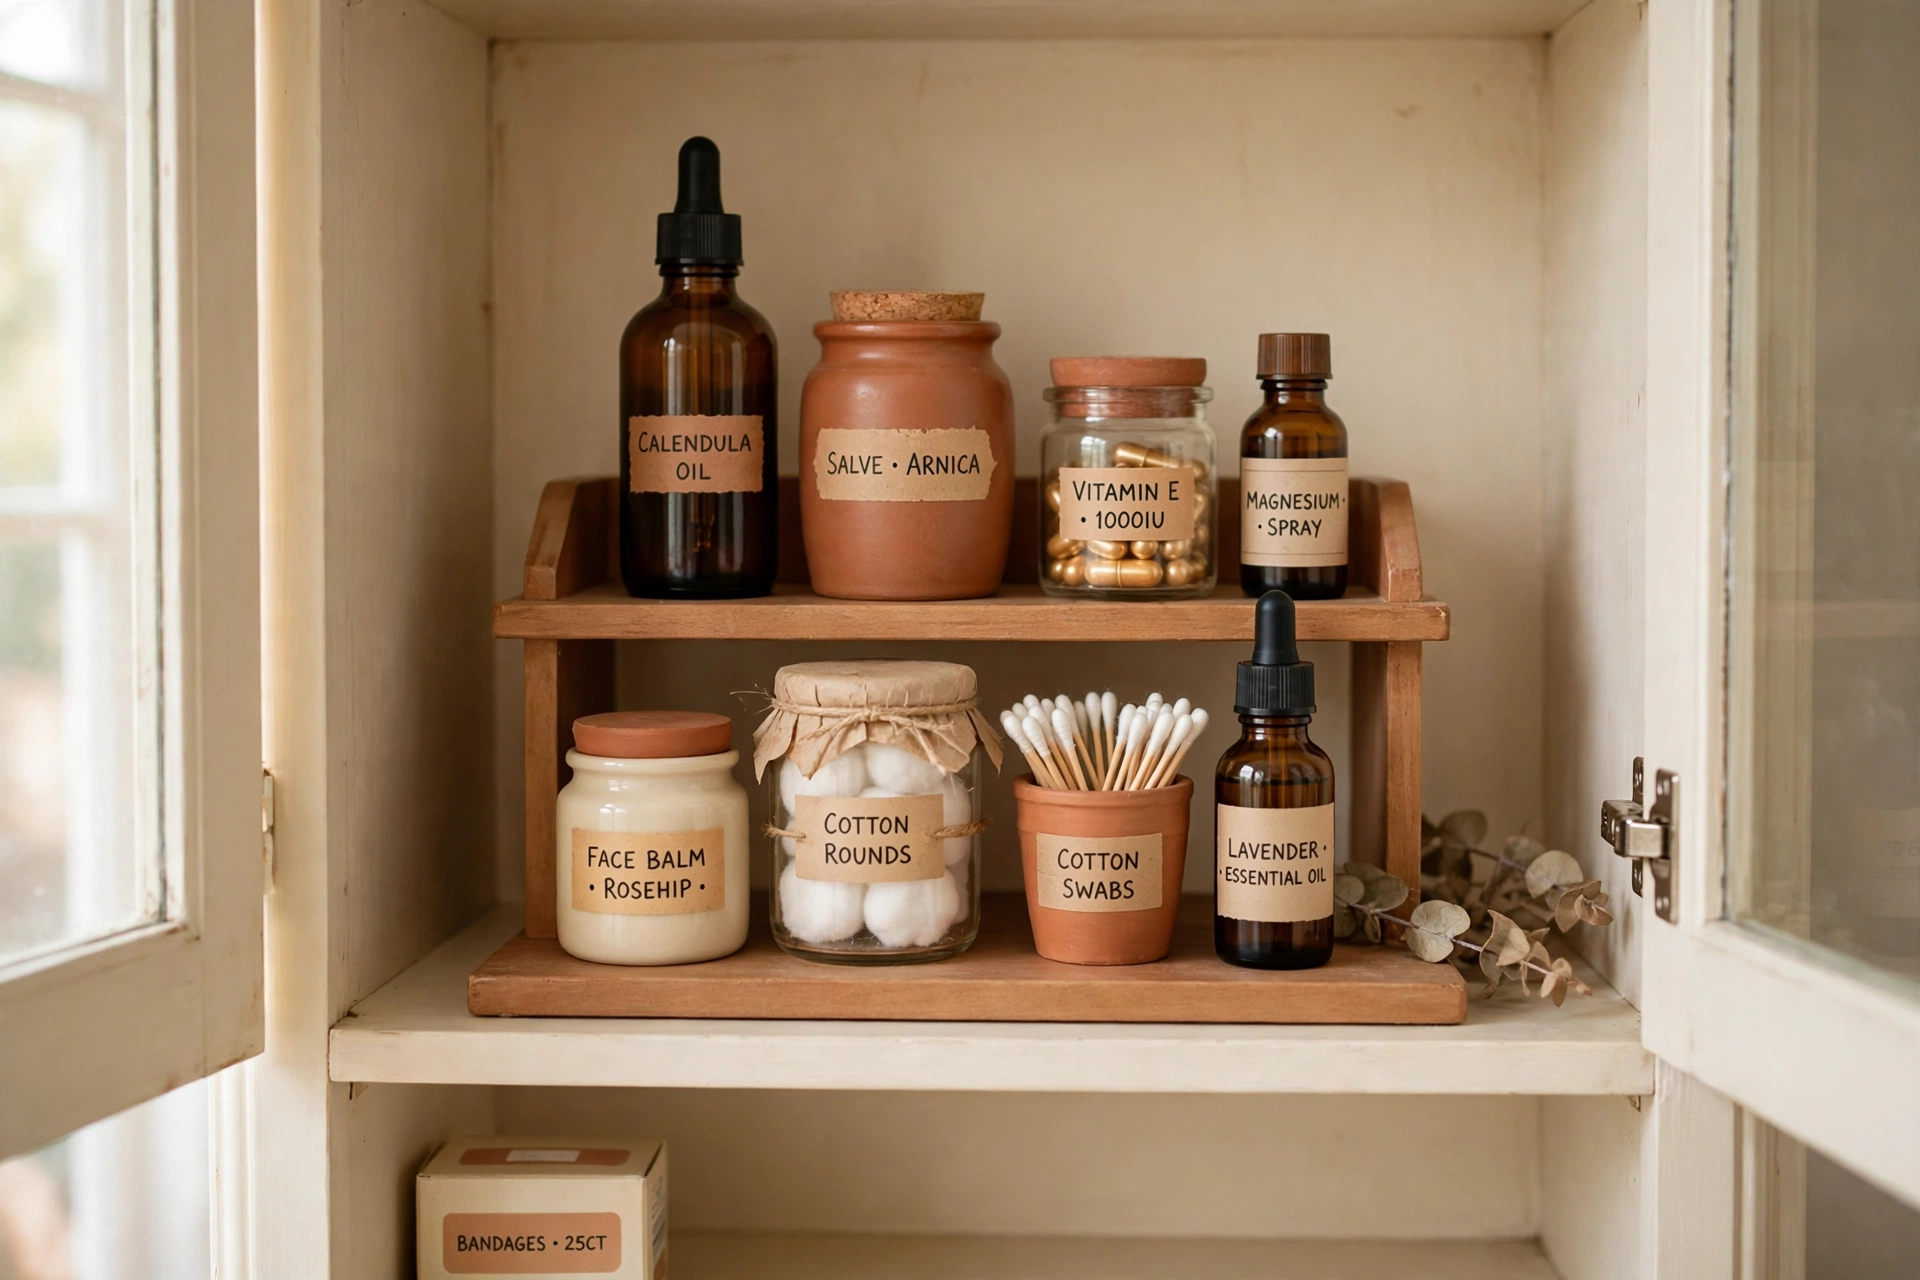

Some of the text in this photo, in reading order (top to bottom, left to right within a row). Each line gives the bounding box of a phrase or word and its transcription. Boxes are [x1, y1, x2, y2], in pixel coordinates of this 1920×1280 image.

[638, 431, 752, 453] CALENDULA
[676, 461, 712, 481] OIL
[826, 451, 980, 476] SALVE ARNICA
[1072, 480, 1180, 502] VITAMIN E
[1246, 490, 1340, 511] MAGNESIUM
[1095, 510, 1165, 530] 1000IU
[1267, 517, 1323, 539] SPRAY
[823, 812, 909, 836] COTTON
[587, 845, 706, 871] FACE BALM
[824, 842, 912, 866] ROUNDS
[1057, 848, 1139, 871] COTTON
[1228, 837, 1319, 861] LAVENDER
[1225, 865, 1327, 887] ESSENTIAL OIL
[604, 877, 692, 900] ROSEHIP
[1062, 877, 1135, 901] SWABS
[457, 1234, 607, 1252] BANDAGES 25CT
